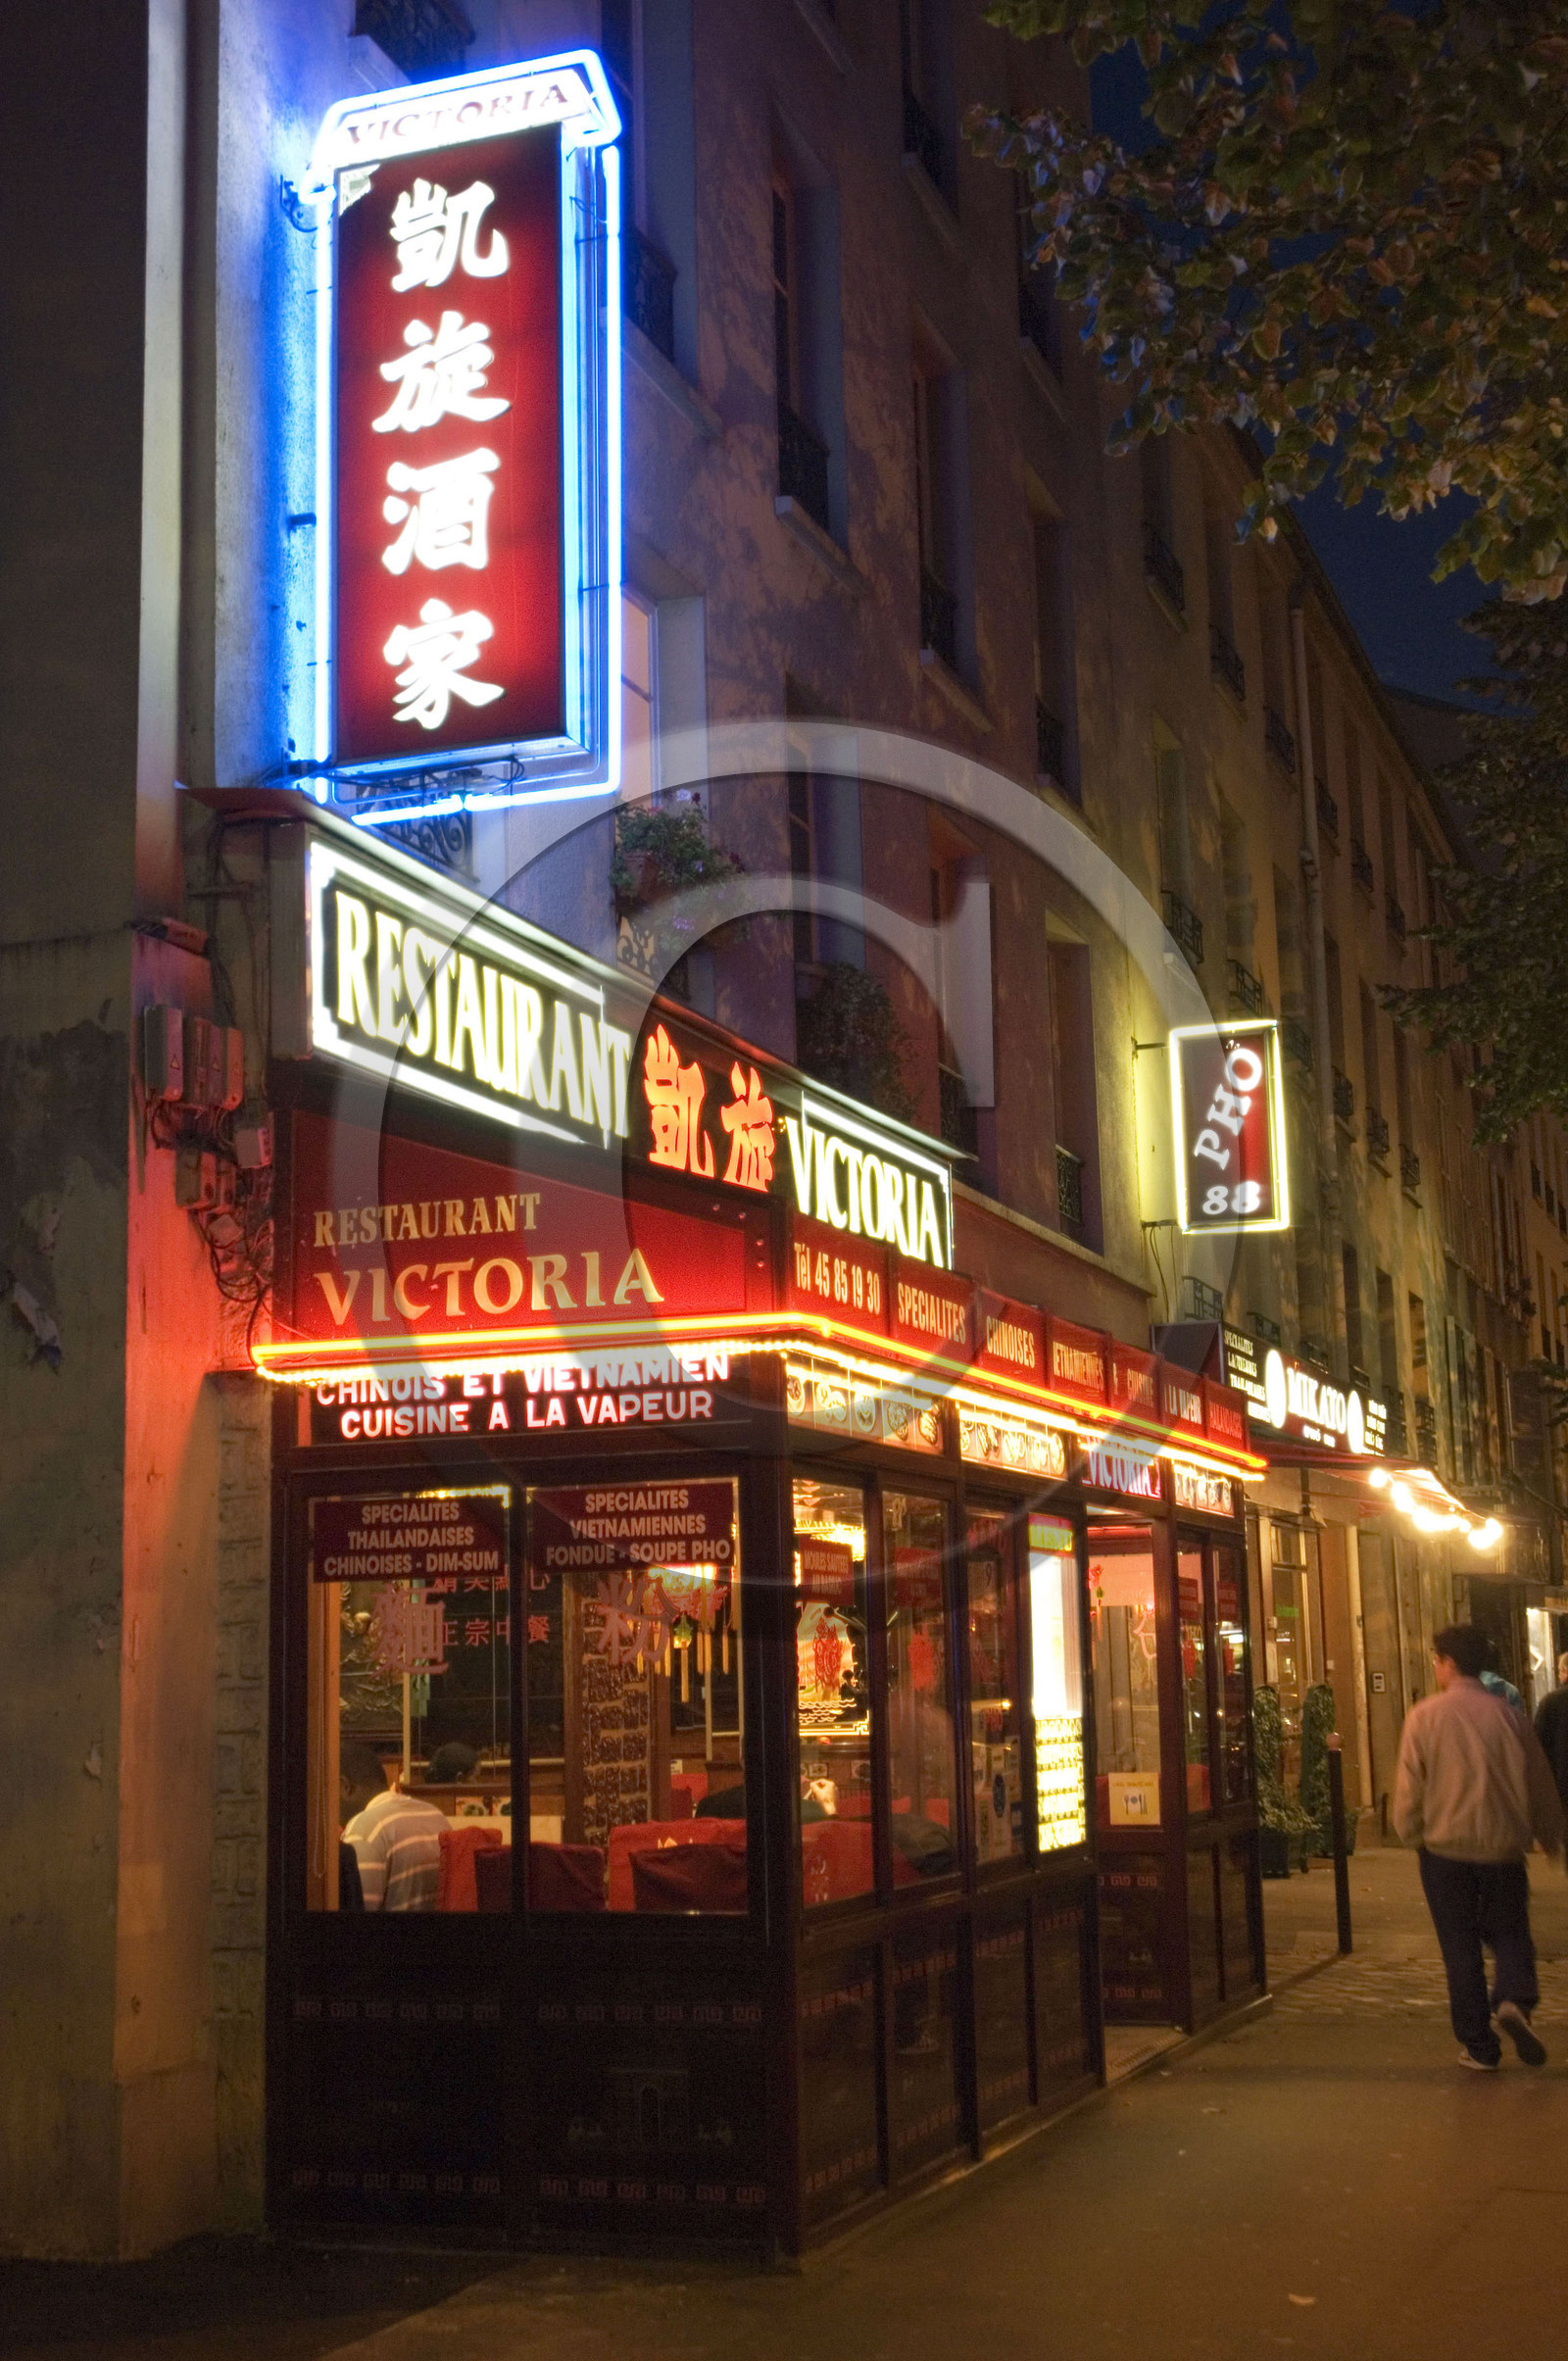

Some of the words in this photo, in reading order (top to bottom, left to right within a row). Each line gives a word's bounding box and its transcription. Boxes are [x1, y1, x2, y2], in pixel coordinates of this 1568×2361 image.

[347, 83, 569, 145] VICTORIA
[371, 177, 511, 730] 凱旋酒家
[335, 890, 632, 1138] RESTAURANT
[786, 1116, 944, 1266] VICTORIA
[643, 1024, 776, 1192] 凱旋
[314, 1193, 541, 1249] RESTAURANT
[1202, 1180, 1261, 1215] 88
[315, 1247, 665, 1326] VICTORIA
[794, 1242, 811, 1292] Tél
[814, 1253, 830, 1295] 45
[833, 1258, 849, 1303] 85
[851, 1263, 864, 1308] 19
[866, 1270, 881, 1315] 30
[897, 1282, 966, 1345] SPECIALITES
[986, 1315, 1036, 1369] CHINOISES
[316, 1370, 445, 1406] CHINOIS
[463, 1367, 506, 1398] ET
[523, 1353, 731, 1395] VIETNAMIEN
[340, 1403, 469, 1440] CUISINE
[488, 1399, 509, 1431] A
[526, 1398, 566, 1429] LA
[578, 1390, 713, 1425] VAPEUR
[361, 1500, 461, 1524] SPECIALITES
[570, 1515, 707, 1540] VIETNAMIENNES
[584, 1490, 689, 1513] SPECIALITES
[323, 1554, 413, 1577] CHINOISES
[425, 1550, 499, 1573] DIM-SUM
[347, 1526, 475, 1550] THAILANDAISES
[546, 1543, 615, 1567] FONDUE
[629, 1541, 688, 1562] SOUPE
[692, 1539, 731, 1560] PHO
